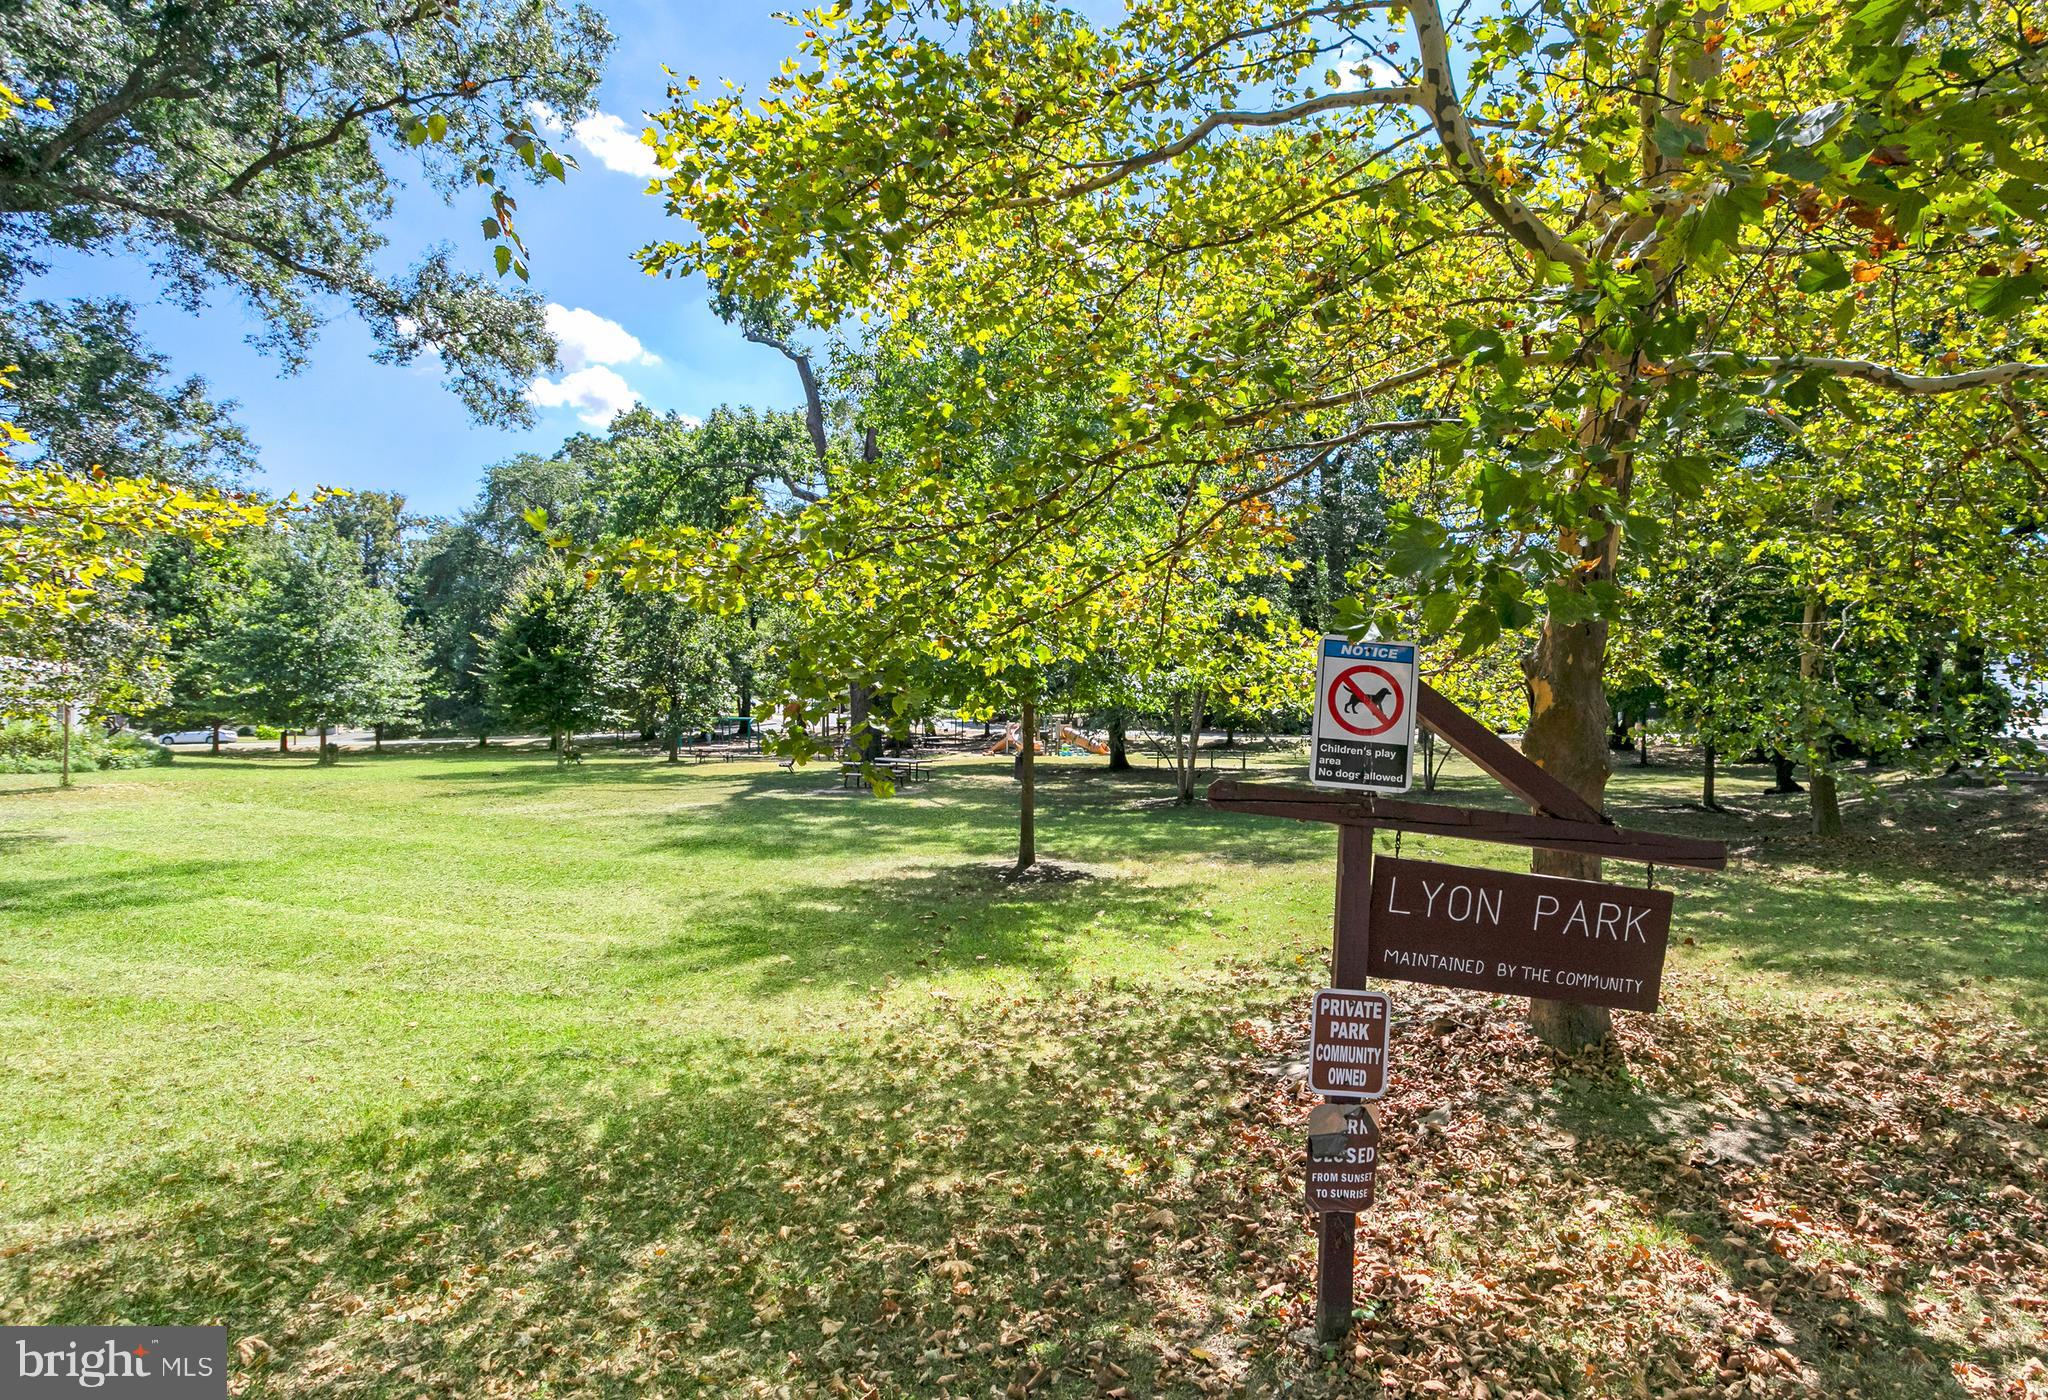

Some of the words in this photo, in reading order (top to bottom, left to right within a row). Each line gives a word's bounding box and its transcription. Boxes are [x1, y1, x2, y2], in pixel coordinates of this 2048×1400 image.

[1341, 645, 1398, 659] NOTICE
[1320, 743, 1372, 756] Children's
[1375, 748, 1396, 760] play
[1319, 757, 1341, 765] area
[1318, 767, 1333, 777] No
[1363, 771, 1403, 783] allowed
[1388, 876, 1503, 926] LYON
[1533, 895, 1652, 944] PARK
[1383, 949, 1485, 975] MAINTAINED
[1496, 962, 1517, 978] BY
[1521, 965, 1550, 984] THE
[1555, 970, 1643, 994] COMMUNITY
[1320, 998, 1382, 1019] PRIVATE
[1330, 1021, 1370, 1040] PARK
[1316, 1043, 1381, 1065] COMMUNITY
[1328, 1067, 1367, 1087] OWNED
[1311, 1172, 1338, 1182] FROM
[1341, 1172, 1373, 1183] SUNSET
[1316, 1188, 1328, 1198] TO
[1330, 1188, 1368, 1199] SUNRISE
